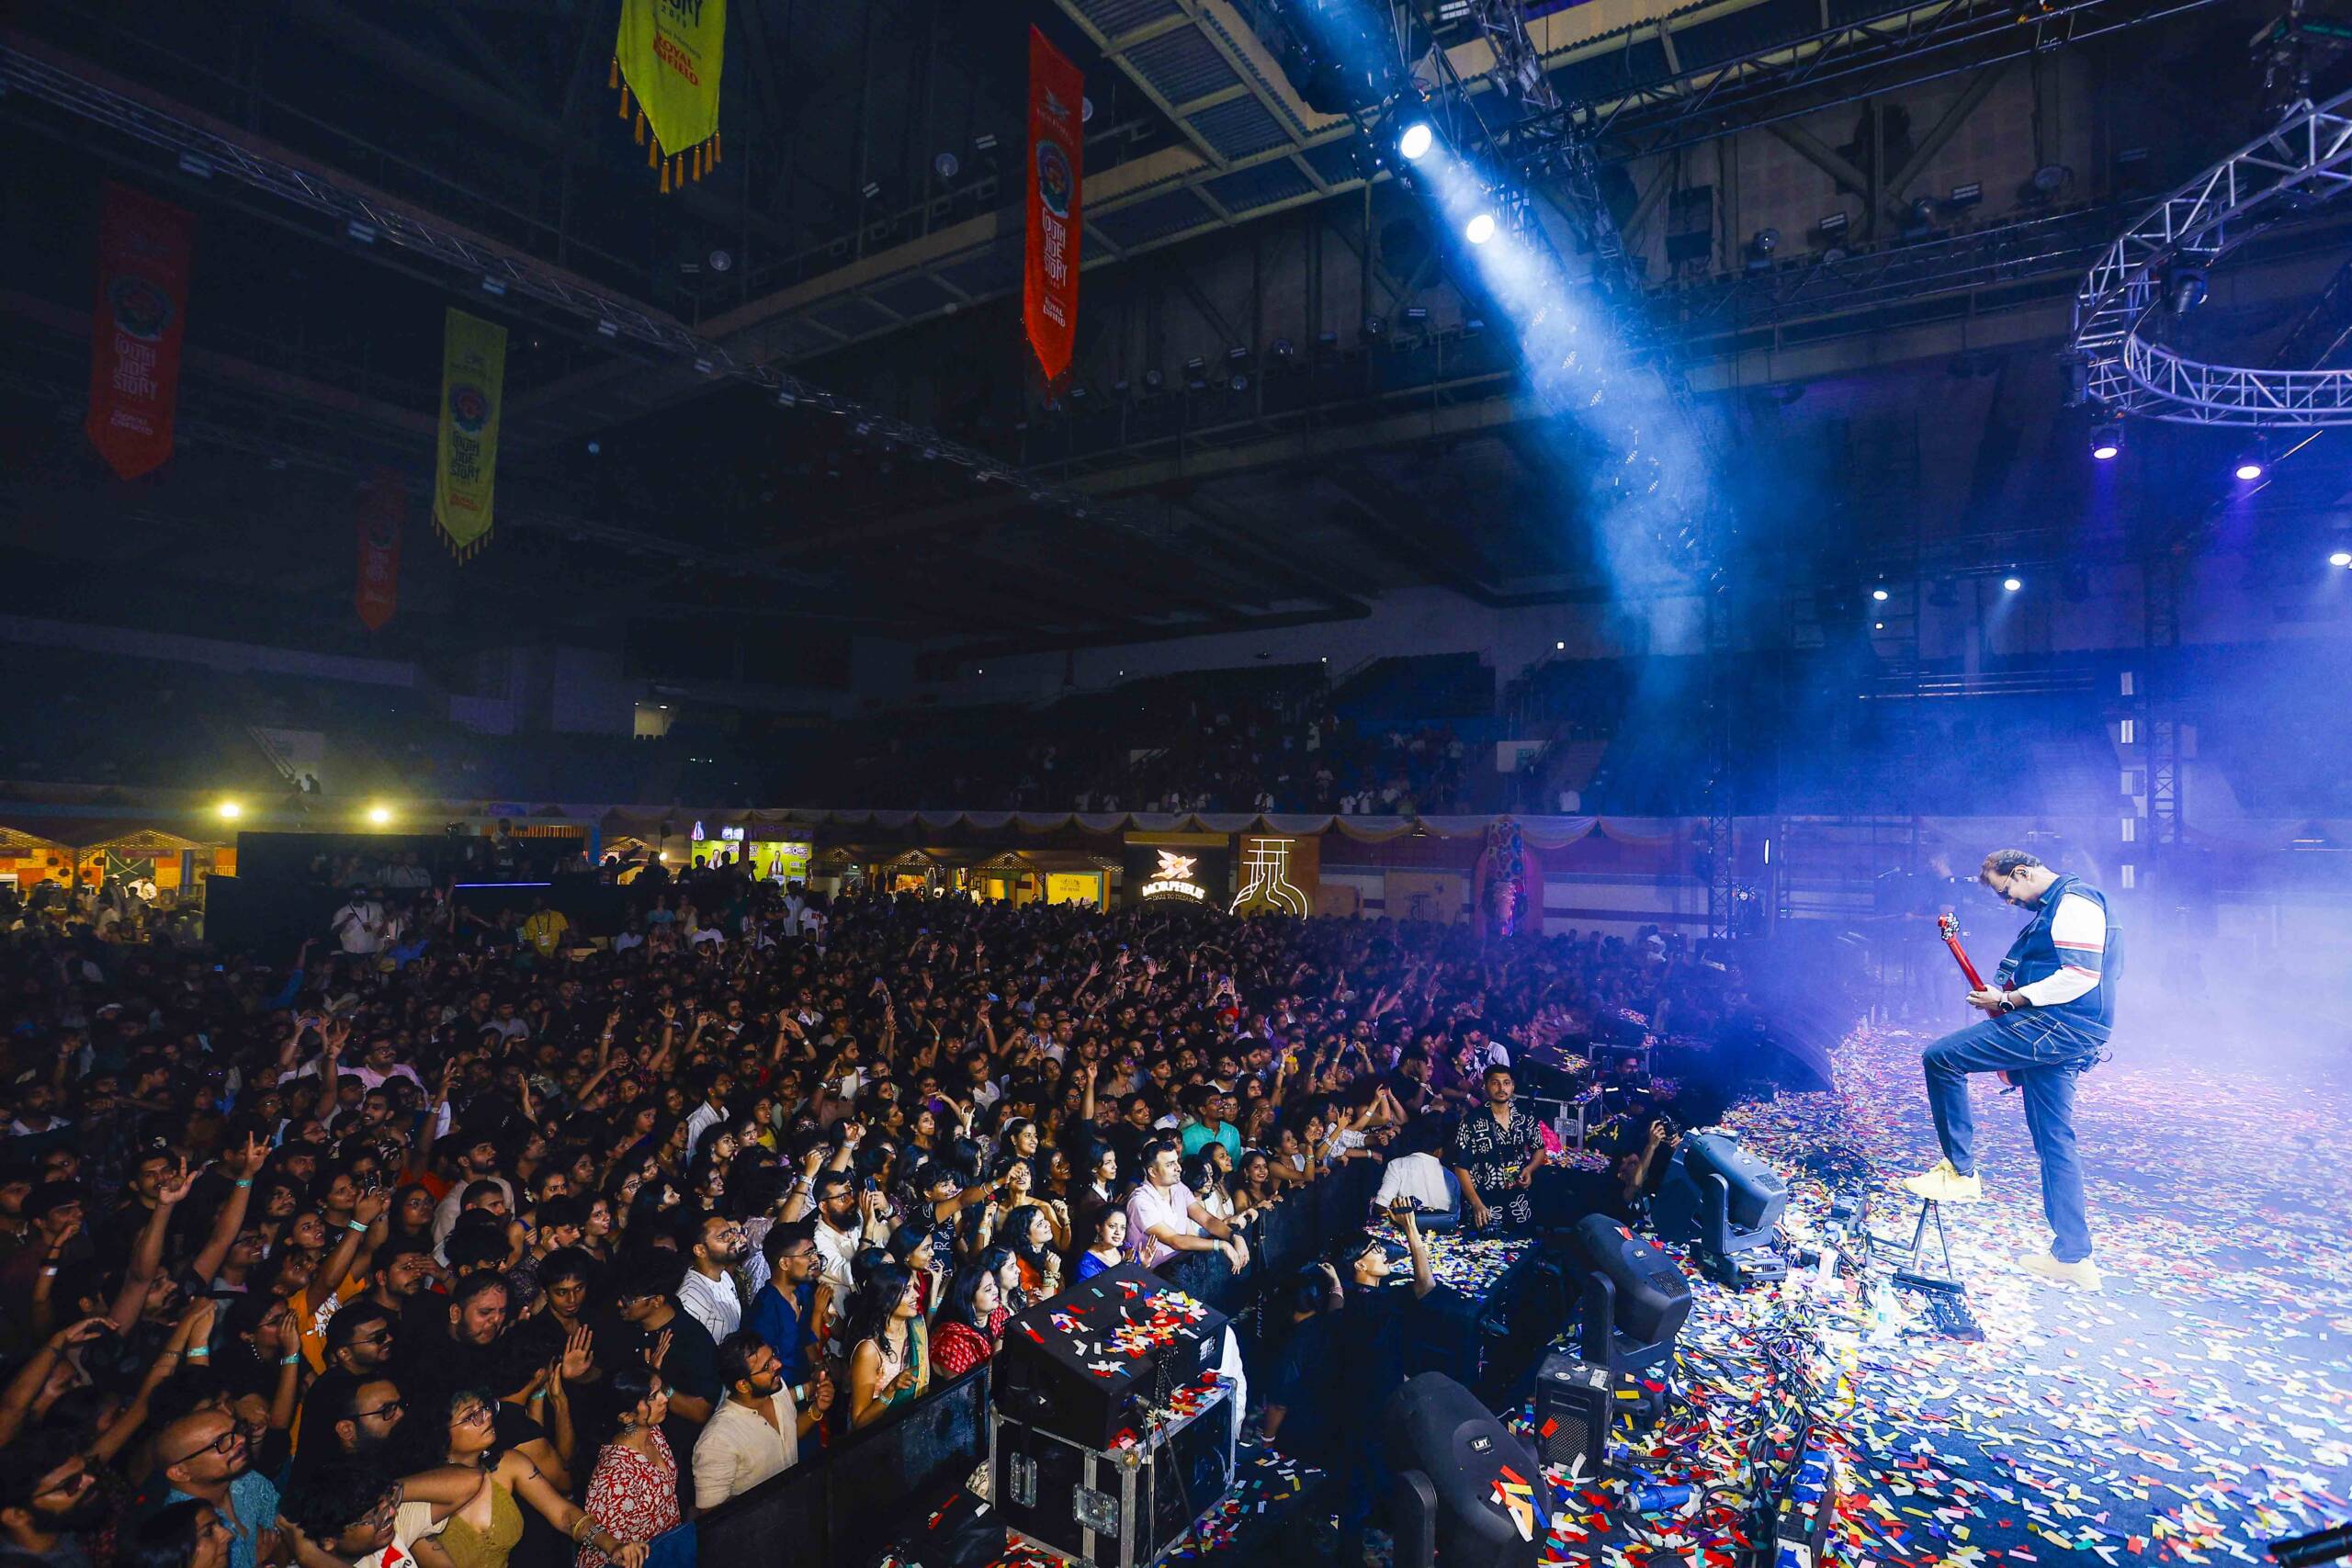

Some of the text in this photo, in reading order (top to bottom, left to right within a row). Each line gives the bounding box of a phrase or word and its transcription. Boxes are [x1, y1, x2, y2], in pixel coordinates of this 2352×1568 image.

[653, 41, 699, 86] ENFIELD
[655, 30, 694, 71] ROYAL
[1044, 253, 1068, 288] STORY
[1046, 297, 1064, 317] ROYAL
[113, 369, 158, 400] STORY
[450, 461, 480, 483] STORY
[1142, 881, 1205, 899] MORPHEUS
